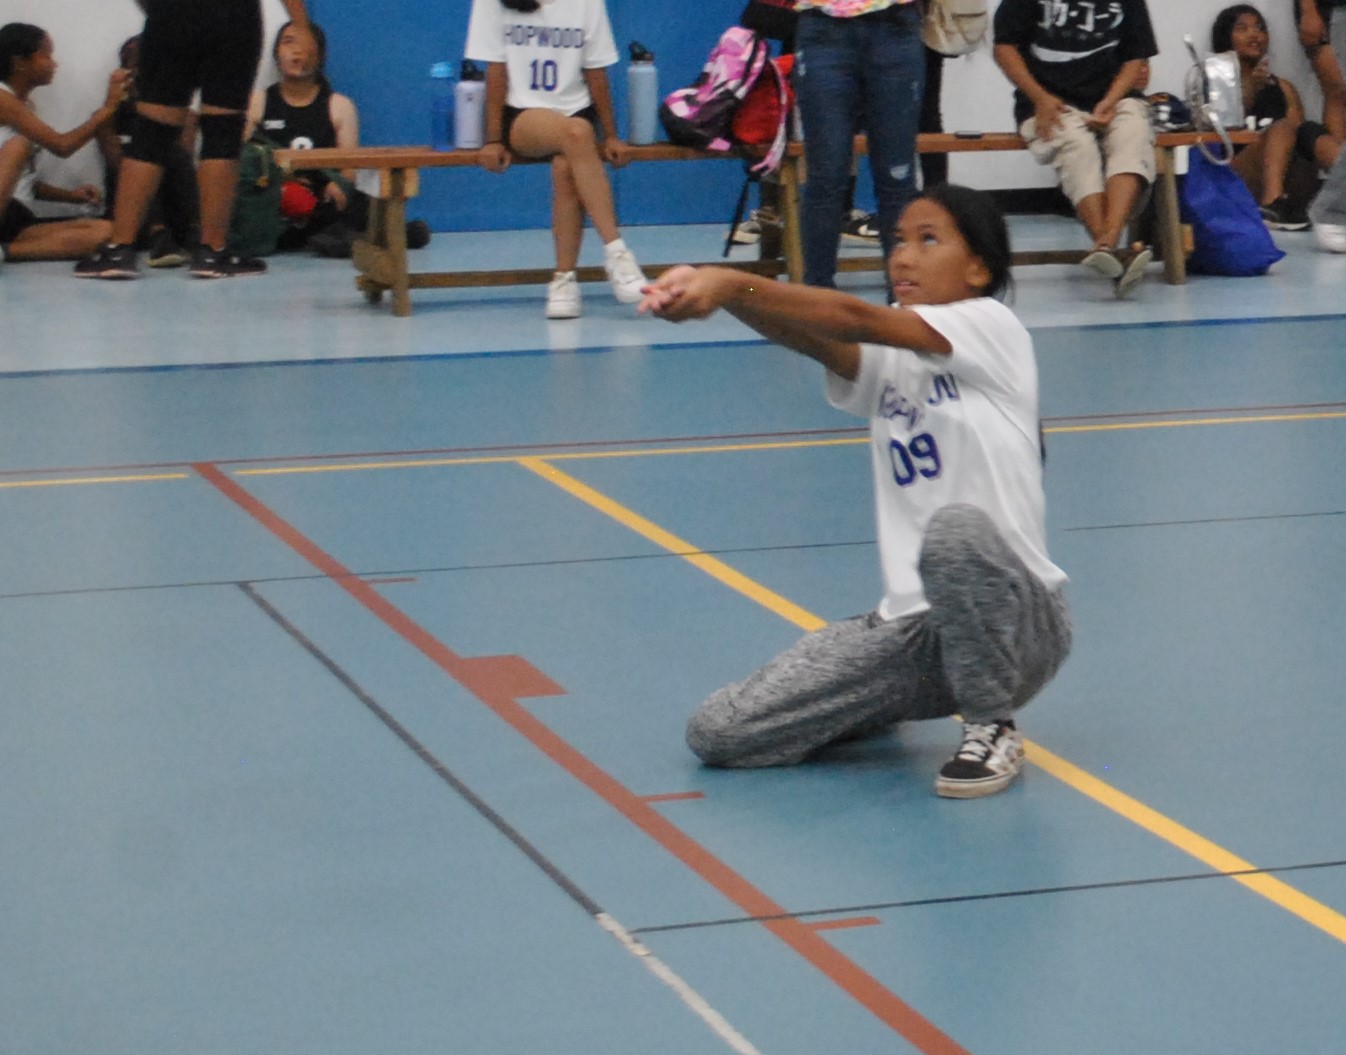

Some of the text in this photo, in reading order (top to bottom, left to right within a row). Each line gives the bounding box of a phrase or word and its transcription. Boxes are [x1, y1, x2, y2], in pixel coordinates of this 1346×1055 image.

[503, 24, 585, 49] HOPWOOD
[530, 59, 558, 92] 10
[889, 432, 942, 487] 09
